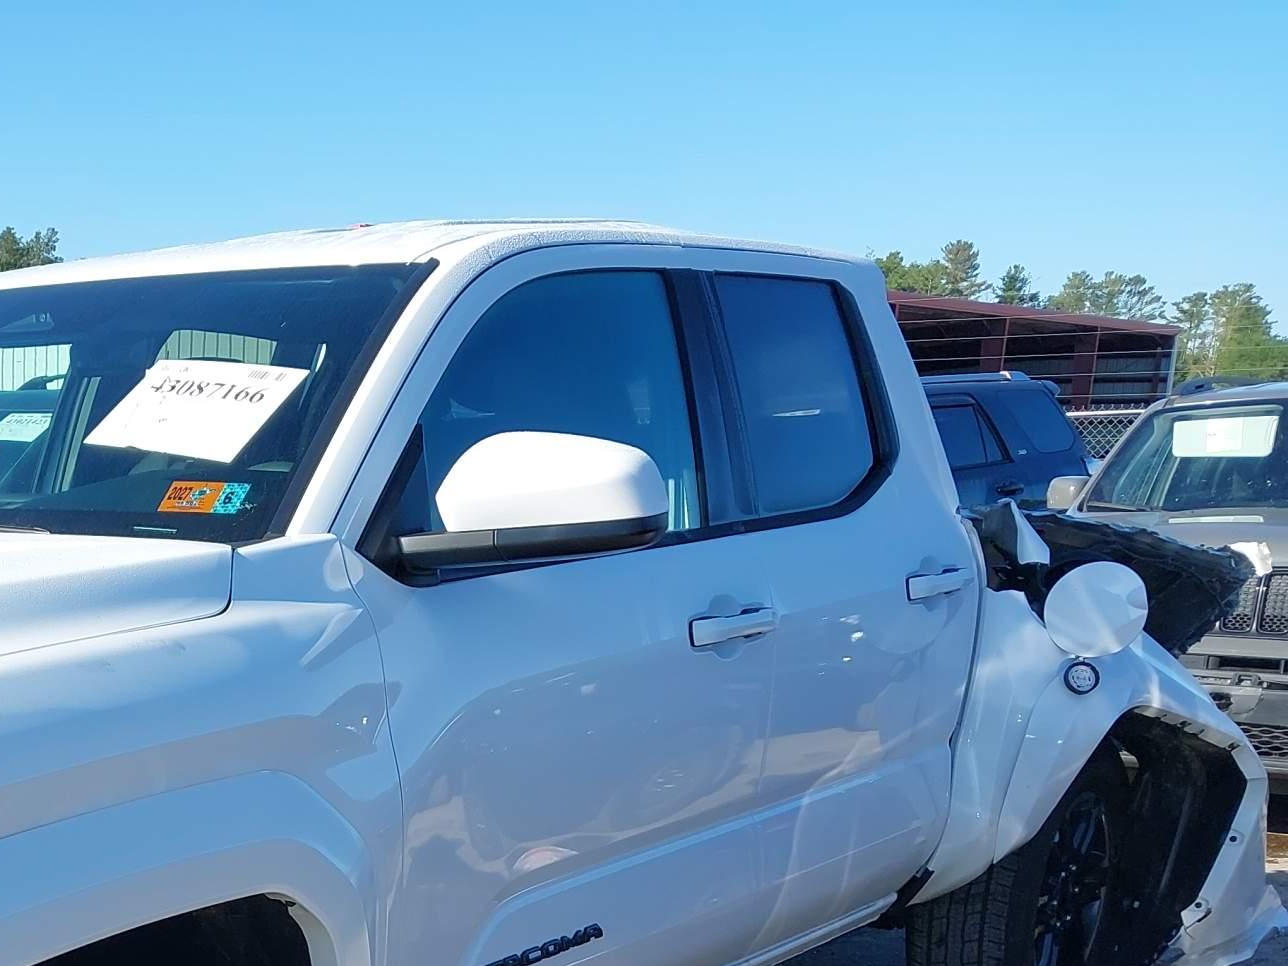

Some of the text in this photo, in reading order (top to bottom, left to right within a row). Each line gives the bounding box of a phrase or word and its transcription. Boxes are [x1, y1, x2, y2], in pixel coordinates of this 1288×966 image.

[151, 375, 269, 404] 43087166
[166, 487, 194, 500] 2027
[223, 492, 235, 505] 6
